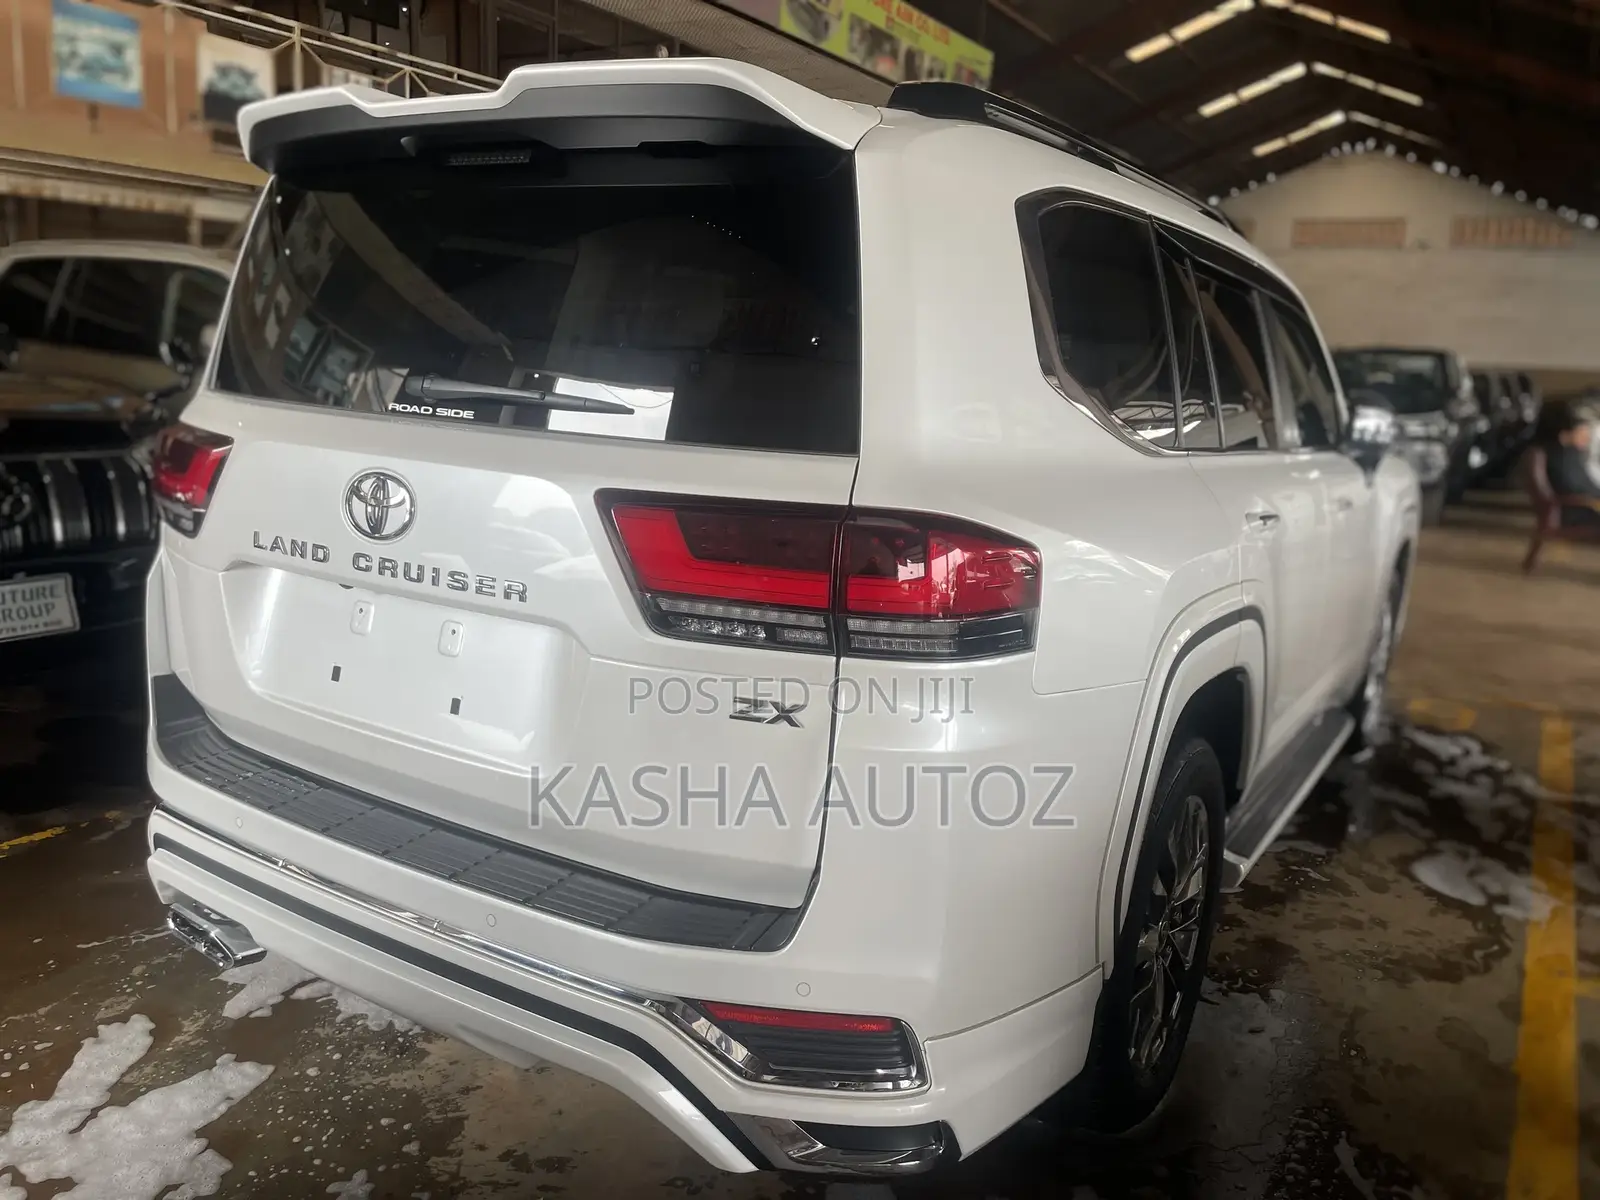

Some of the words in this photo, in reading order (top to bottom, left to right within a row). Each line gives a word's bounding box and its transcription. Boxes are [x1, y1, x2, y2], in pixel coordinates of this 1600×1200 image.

[388, 402, 433, 415] ROAD
[435, 407, 475, 419] SIDE
[252, 530, 331, 564] LAND
[351, 551, 530, 603] CRUISER
[0, 602, 56, 624] ROUP
[729, 696, 804, 728] ZX
